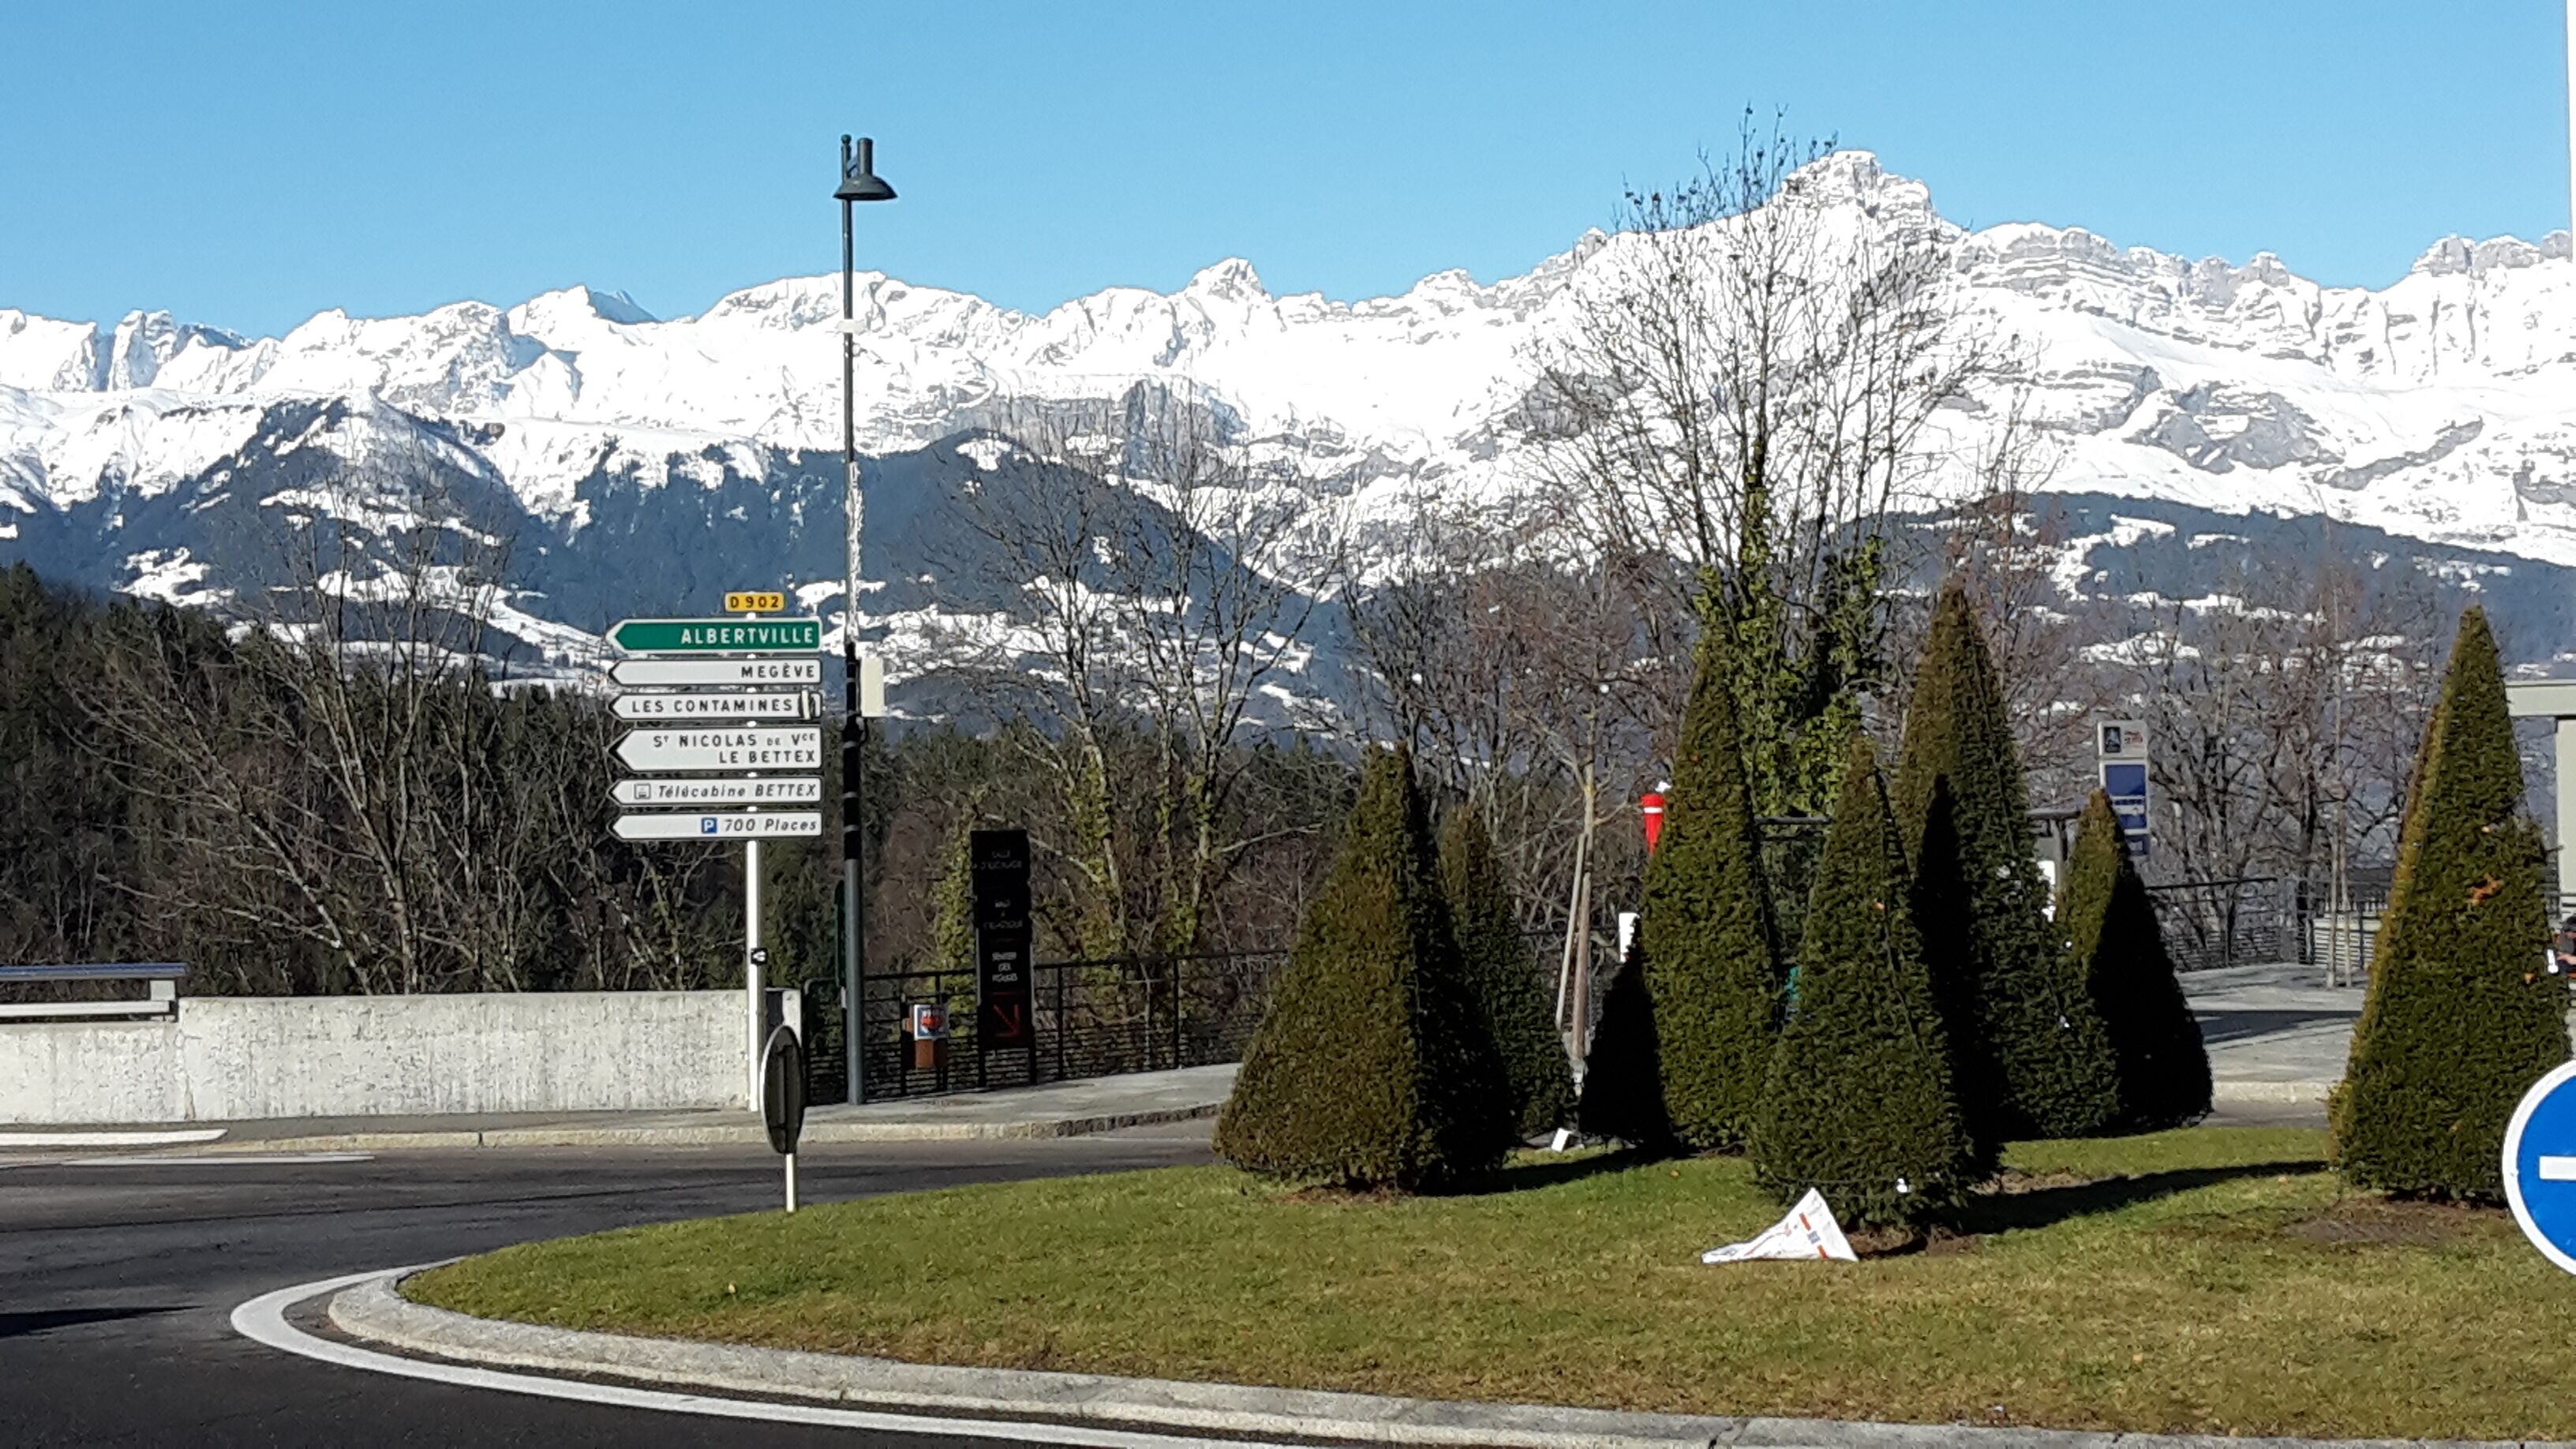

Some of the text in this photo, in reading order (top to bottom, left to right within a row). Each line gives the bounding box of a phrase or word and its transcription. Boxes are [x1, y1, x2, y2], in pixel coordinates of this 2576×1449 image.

[730, 596, 779, 608] D 902
[680, 627, 814, 645] ALBERTVILLE
[741, 662, 815, 678] MEGÈVE
[632, 698, 793, 713] LES CONTAMINES
[680, 734, 758, 747] NICOLAS
[719, 751, 816, 764] LE BETTEX
[658, 783, 816, 798] Télécabine BETTEX
[724, 818, 756, 831] 700
[764, 818, 816, 831] Places
